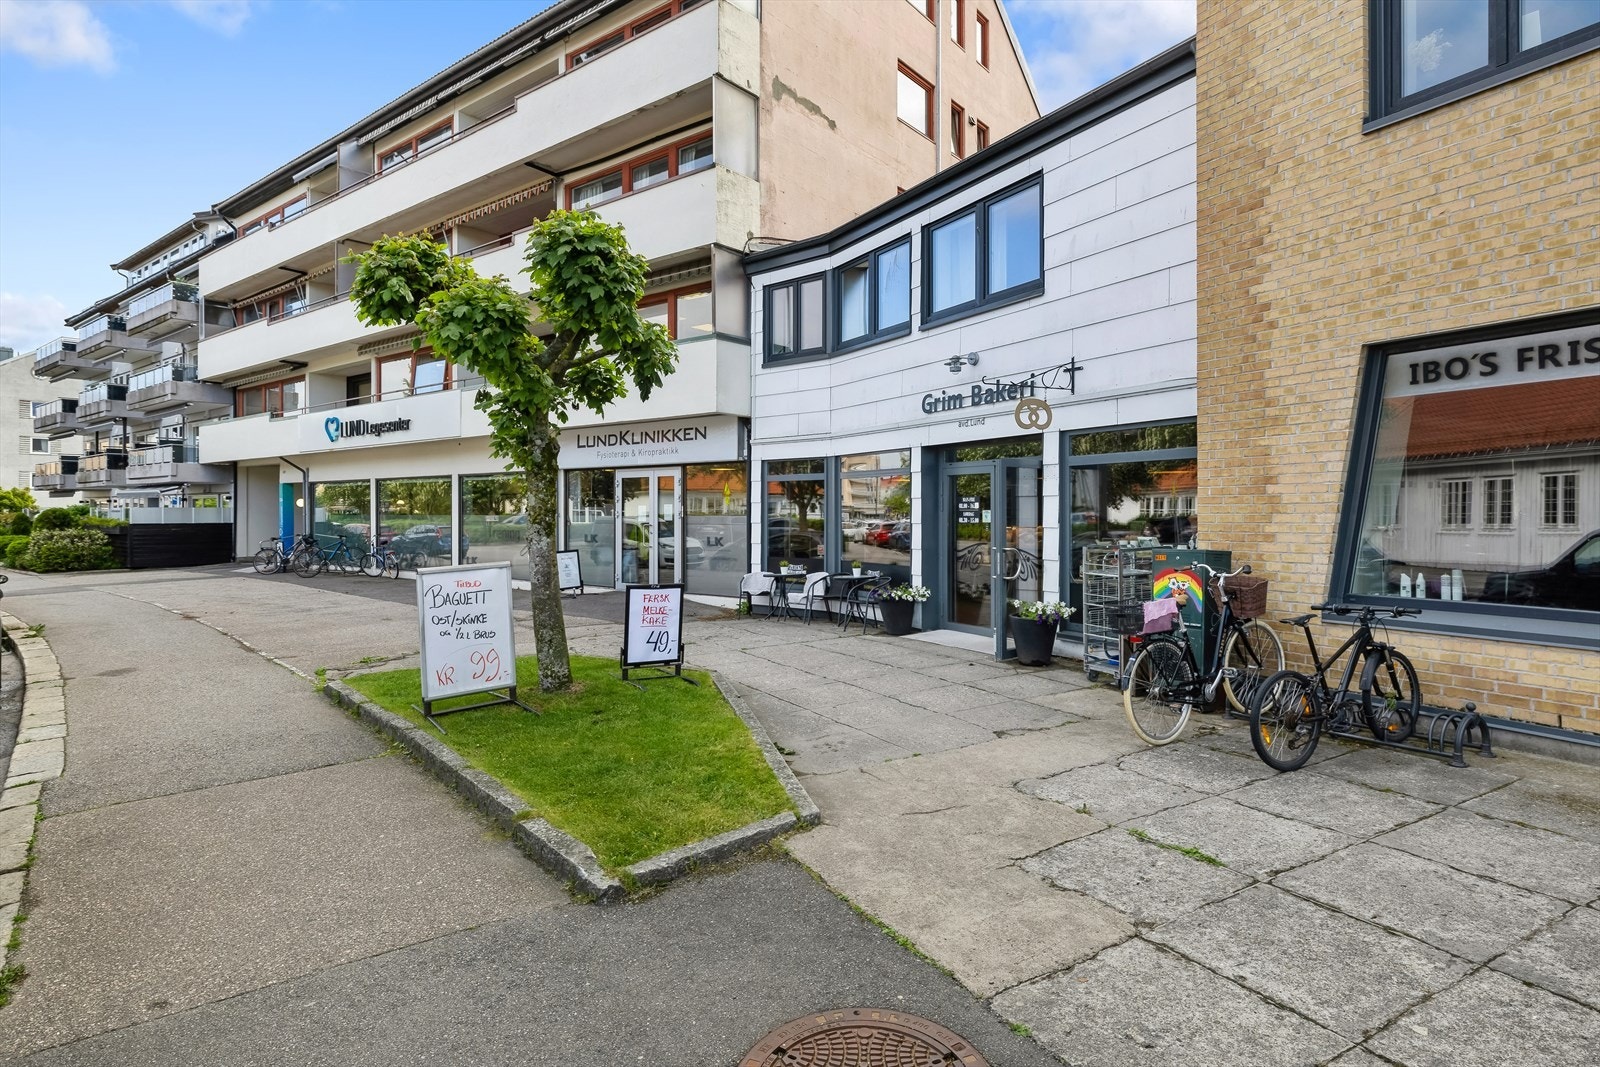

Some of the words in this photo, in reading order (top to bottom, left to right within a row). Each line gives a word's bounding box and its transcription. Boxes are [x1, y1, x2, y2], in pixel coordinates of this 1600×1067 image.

[1517, 337, 1600, 372] FRIS
[922, 390, 963, 414] Grim
[971, 373, 1035, 407] Bakeri
[340, 419, 366, 438] LUND
[366, 417, 411, 437] Legesenter
[596, 450, 630, 460] Fysioterapi
[631, 449, 636, 457] &
[638, 447, 679, 457] Kiropraktikk
[584, 533, 598, 543] LK
[706, 536, 724, 547] LK
[424, 584, 493, 609] BAGUETT
[643, 593, 671, 603] FERSK
[641, 615, 669, 625] KAKE
[473, 630, 496, 639] BRUS
